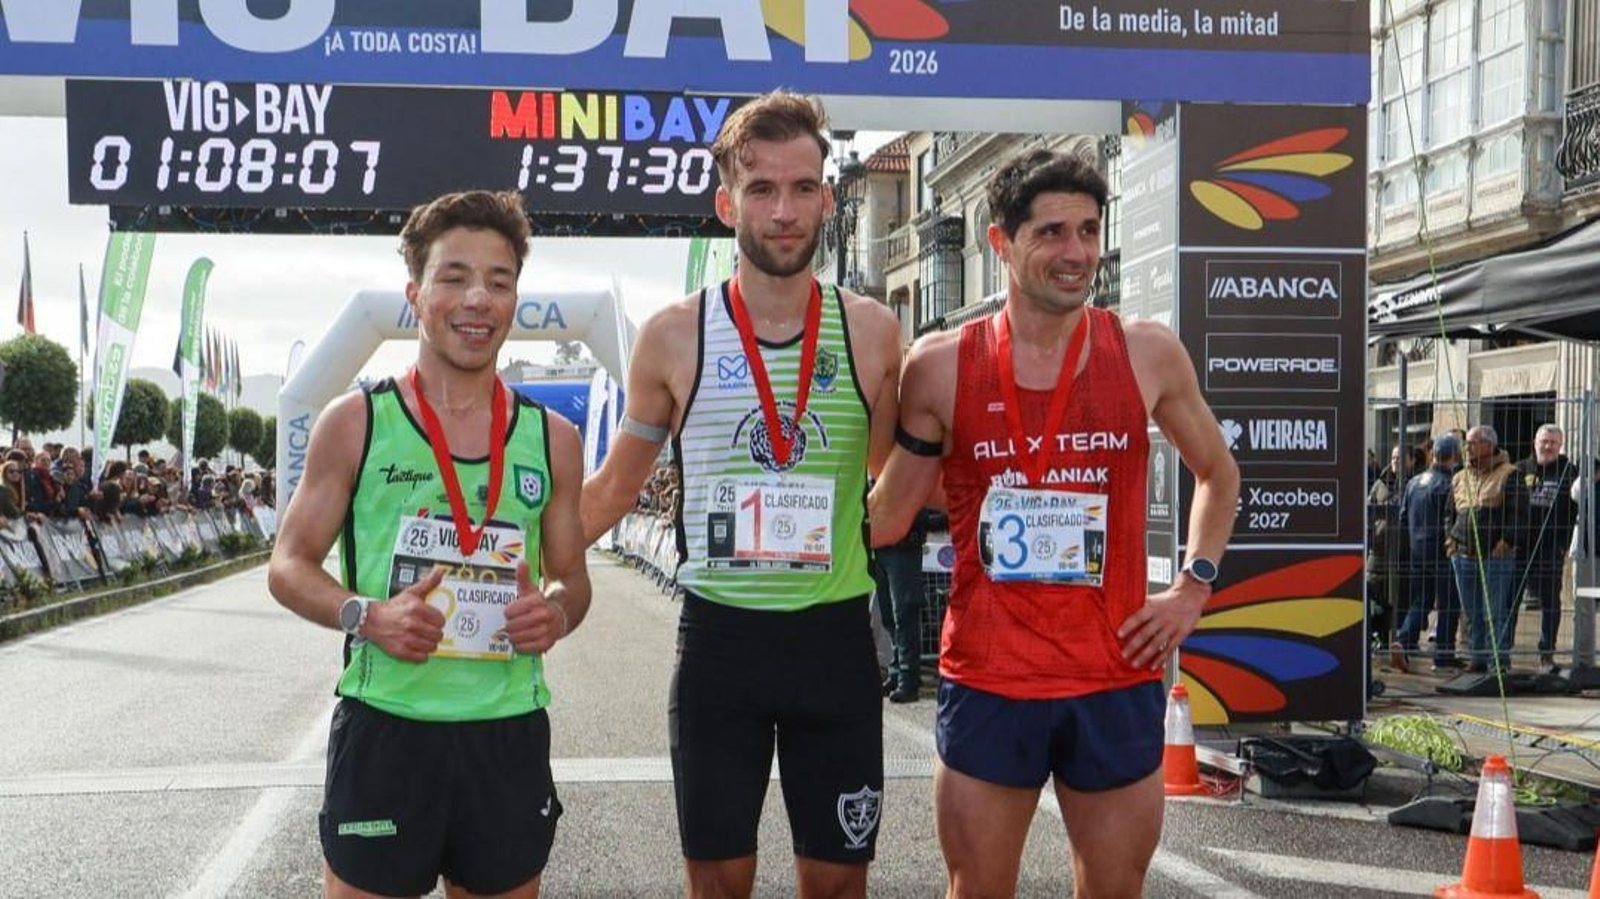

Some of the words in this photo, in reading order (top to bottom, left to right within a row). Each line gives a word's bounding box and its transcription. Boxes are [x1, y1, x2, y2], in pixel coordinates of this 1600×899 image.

[1060, 5, 1085, 31] De
[1092, 6, 1112, 32] la
[1119, 8, 1188, 38] media,
[1194, 9, 1213, 34] la
[1220, 11, 1279, 36] mitad
[325, 31, 345, 56] ¡A
[350, 31, 402, 53] TODA
[408, 32, 476, 54] COSTA!
[890, 49, 938, 74] 2026
[517, 143, 714, 195] 1:37:30
[1209, 357, 1338, 372] POWERADE
[1056, 432, 1128, 452] TEAM
[1248, 418, 1328, 451] VIEIRASA
[1248, 487, 1334, 507] Xacobeo
[741, 488, 762, 550] 1
[764, 494, 828, 510] CLASIFICADO
[1248, 512, 1290, 529] 2027
[410, 528, 429, 548] 25
[998, 513, 1028, 570] 3
[1026, 514, 1082, 528] CLASIFICADO
